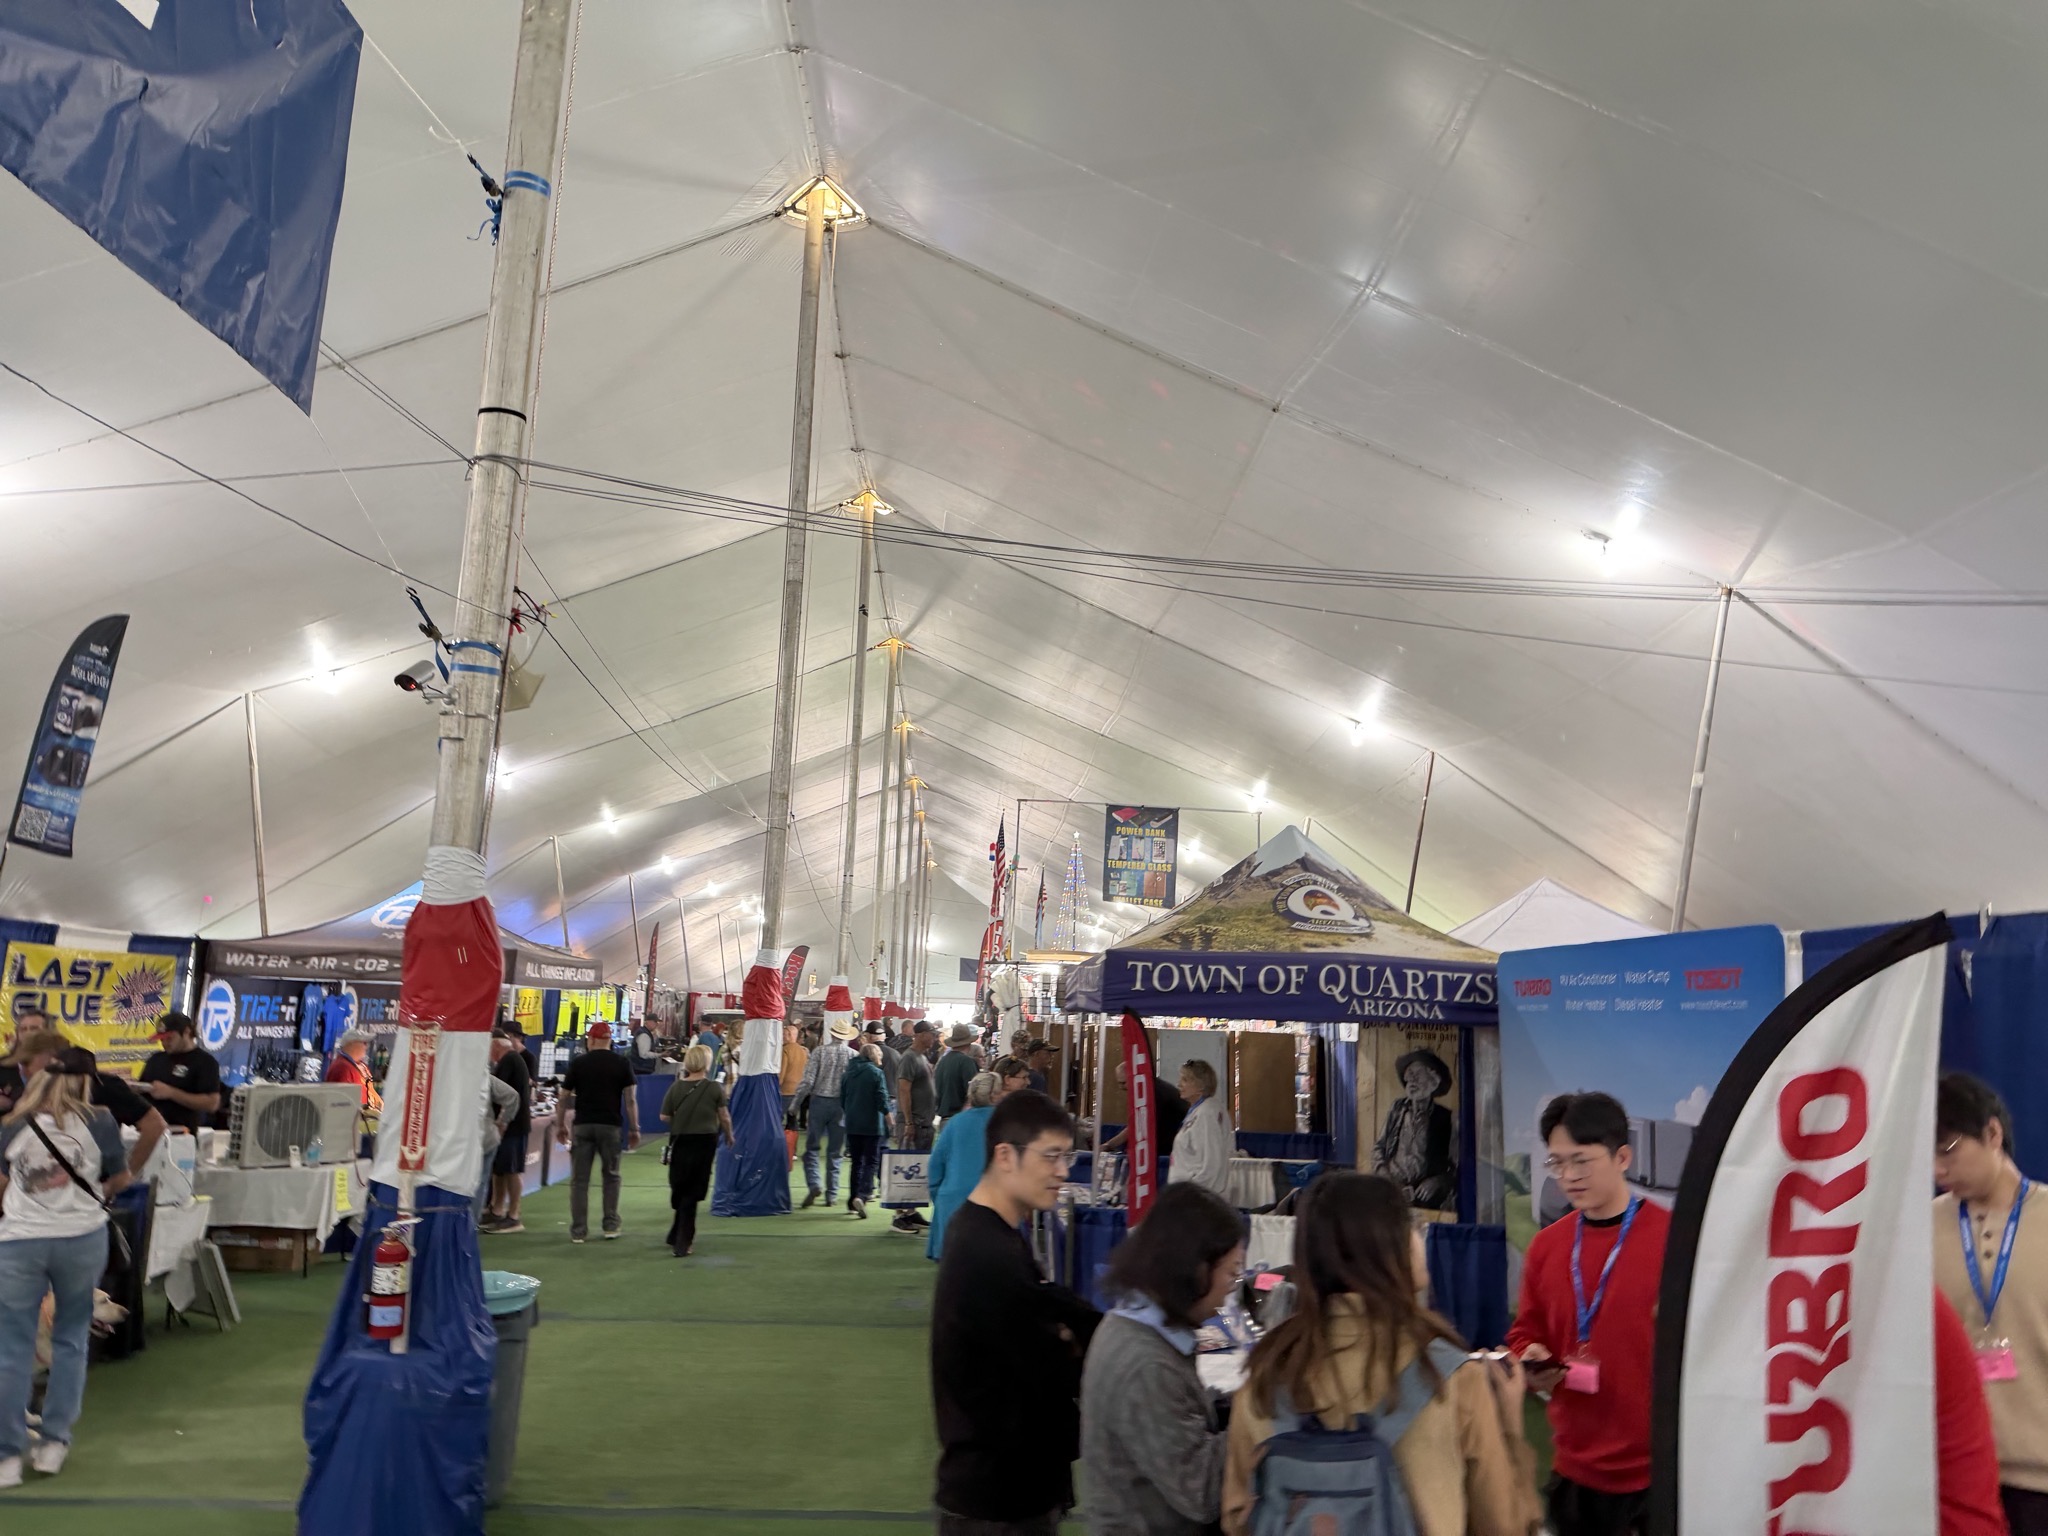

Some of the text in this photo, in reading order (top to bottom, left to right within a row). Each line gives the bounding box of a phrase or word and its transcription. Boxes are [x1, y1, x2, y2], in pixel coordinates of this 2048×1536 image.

[1116, 826, 1166, 837] POWER BANK
[1107, 860, 1172, 873] TEMPERED GLASS
[1143, 898, 1164, 908] CASE
[13, 953, 113, 988] LAST
[226, 952, 290, 968] WATER
[305, 956, 337, 970] AIR
[353, 958, 389, 972] CO2
[525, 962, 596, 982] ALL THINGS INFLATION
[1127, 961, 1246, 994] TOWN
[1258, 965, 1308, 995] OF
[1318, 963, 1498, 1005] QUARTZS
[1578, 973, 1617, 986] Conditioner
[1623, 971, 1646, 985] Water
[1646, 969, 1671, 987] Pump
[12, 992, 104, 1026] GLUE
[240, 994, 299, 1022] TIRE-R
[1347, 998, 1445, 1020] ARIZONA
[236, 1026, 253, 1039] ALL
[1132, 1043, 1150, 1209] TOSOT
